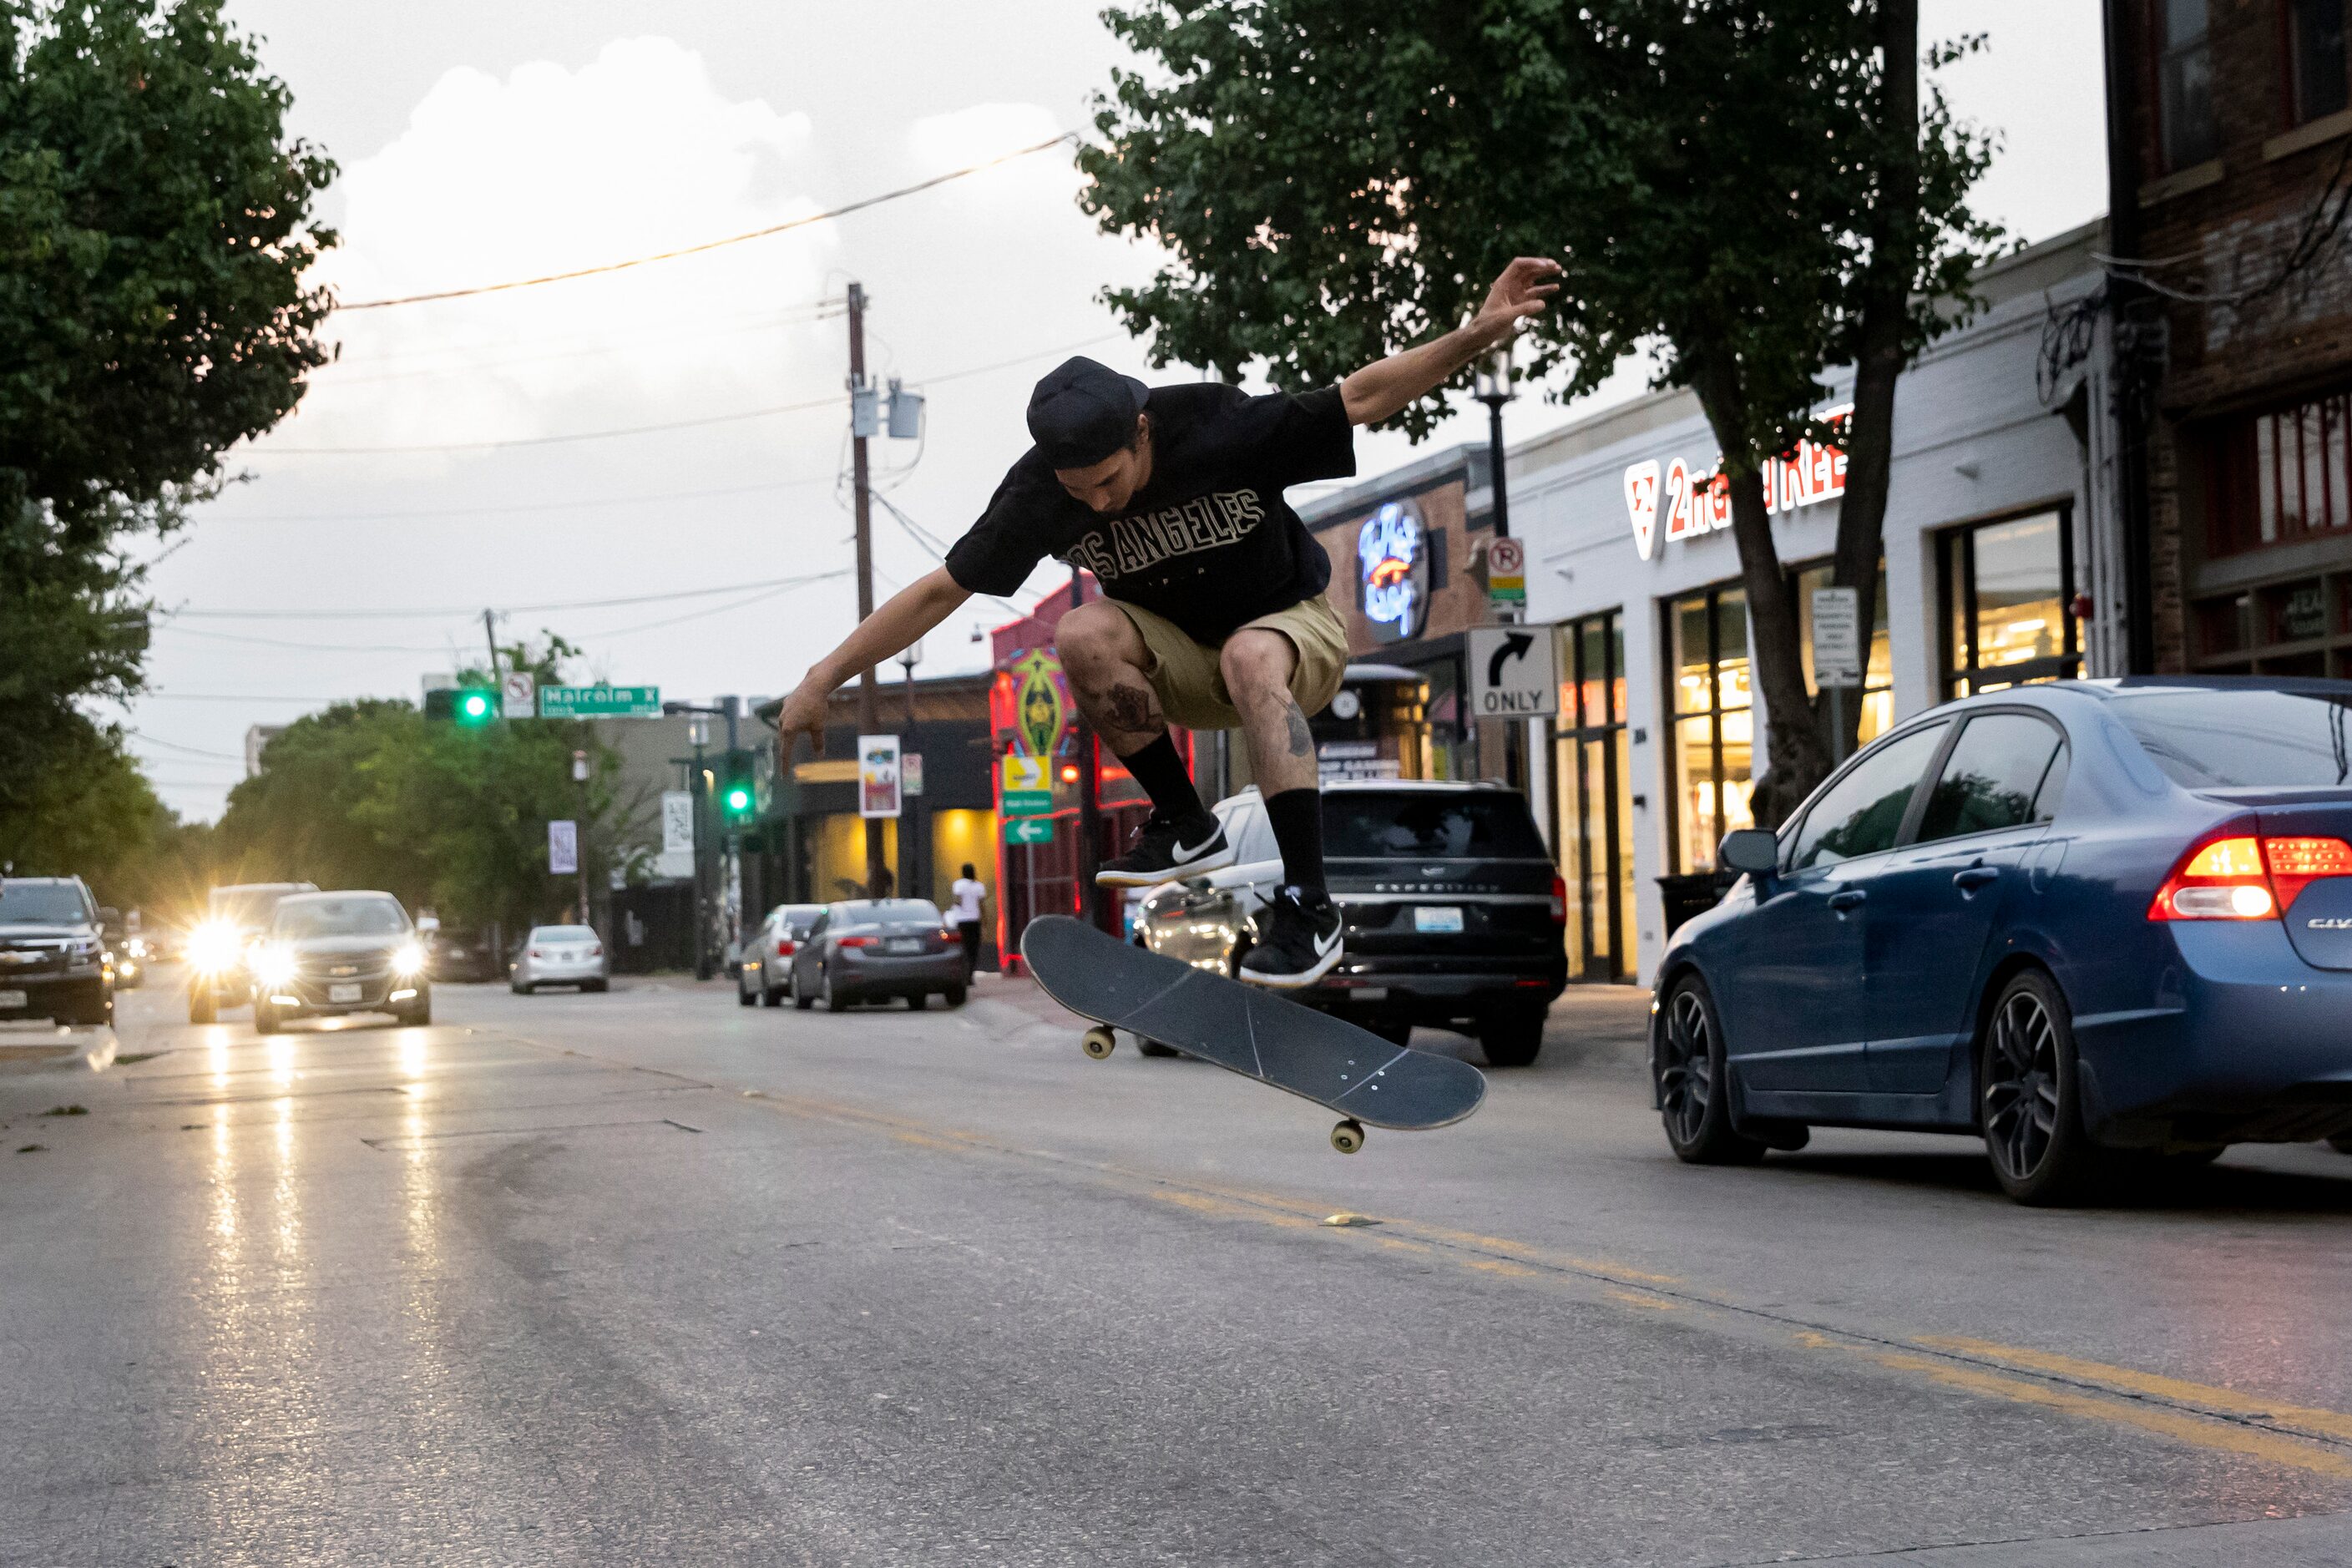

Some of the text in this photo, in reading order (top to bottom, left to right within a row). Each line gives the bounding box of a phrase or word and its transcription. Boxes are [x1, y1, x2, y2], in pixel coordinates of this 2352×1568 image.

[1110, 488, 1266, 574] ANGELES
[546, 689, 656, 703] Malcolm X
[1485, 690, 1544, 711] ONLY
[1374, 883, 1500, 893] EXPEDITION
